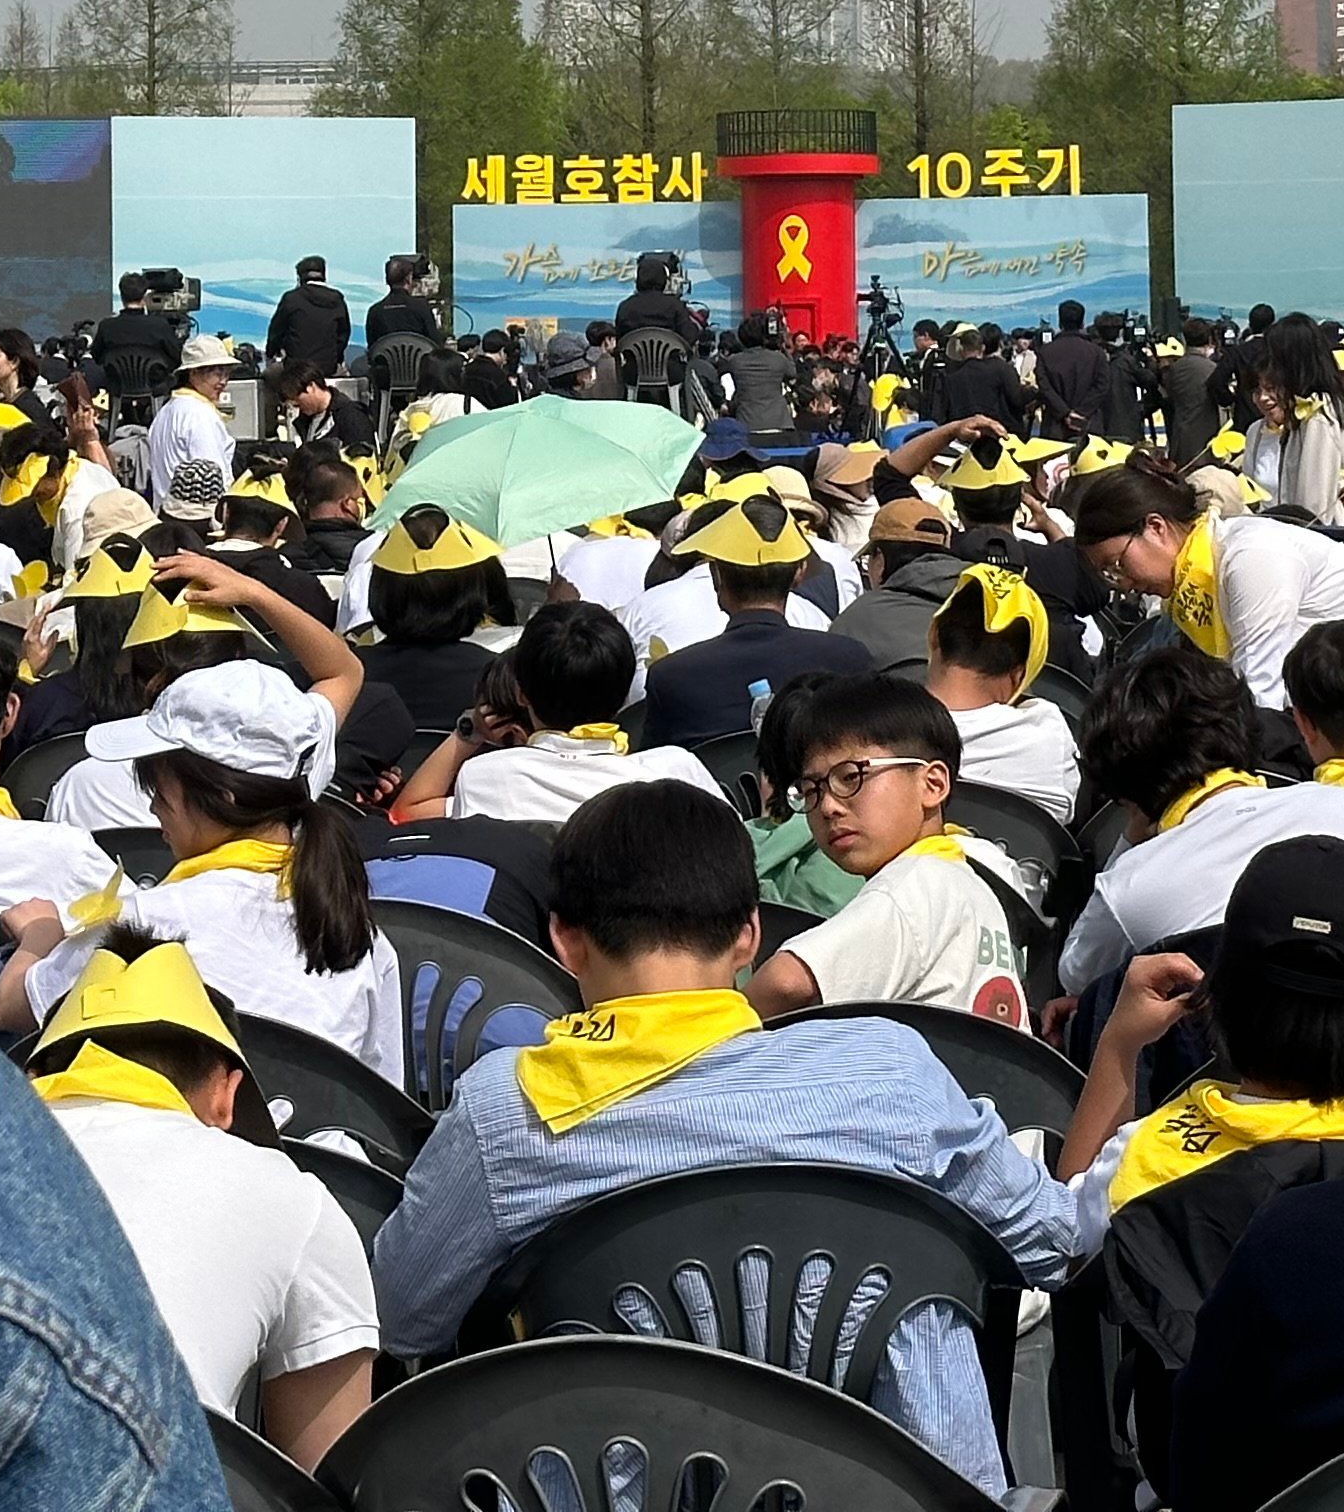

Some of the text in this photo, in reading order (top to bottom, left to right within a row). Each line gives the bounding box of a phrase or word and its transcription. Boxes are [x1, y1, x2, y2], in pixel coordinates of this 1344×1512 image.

[461, 152, 708, 204] 세월호참사
[907, 144, 1081, 199] 10주기
[504, 242, 581, 284] 가슴에
[922, 241, 1002, 282] 마음에
[1043, 240, 1087, 275] 약속
